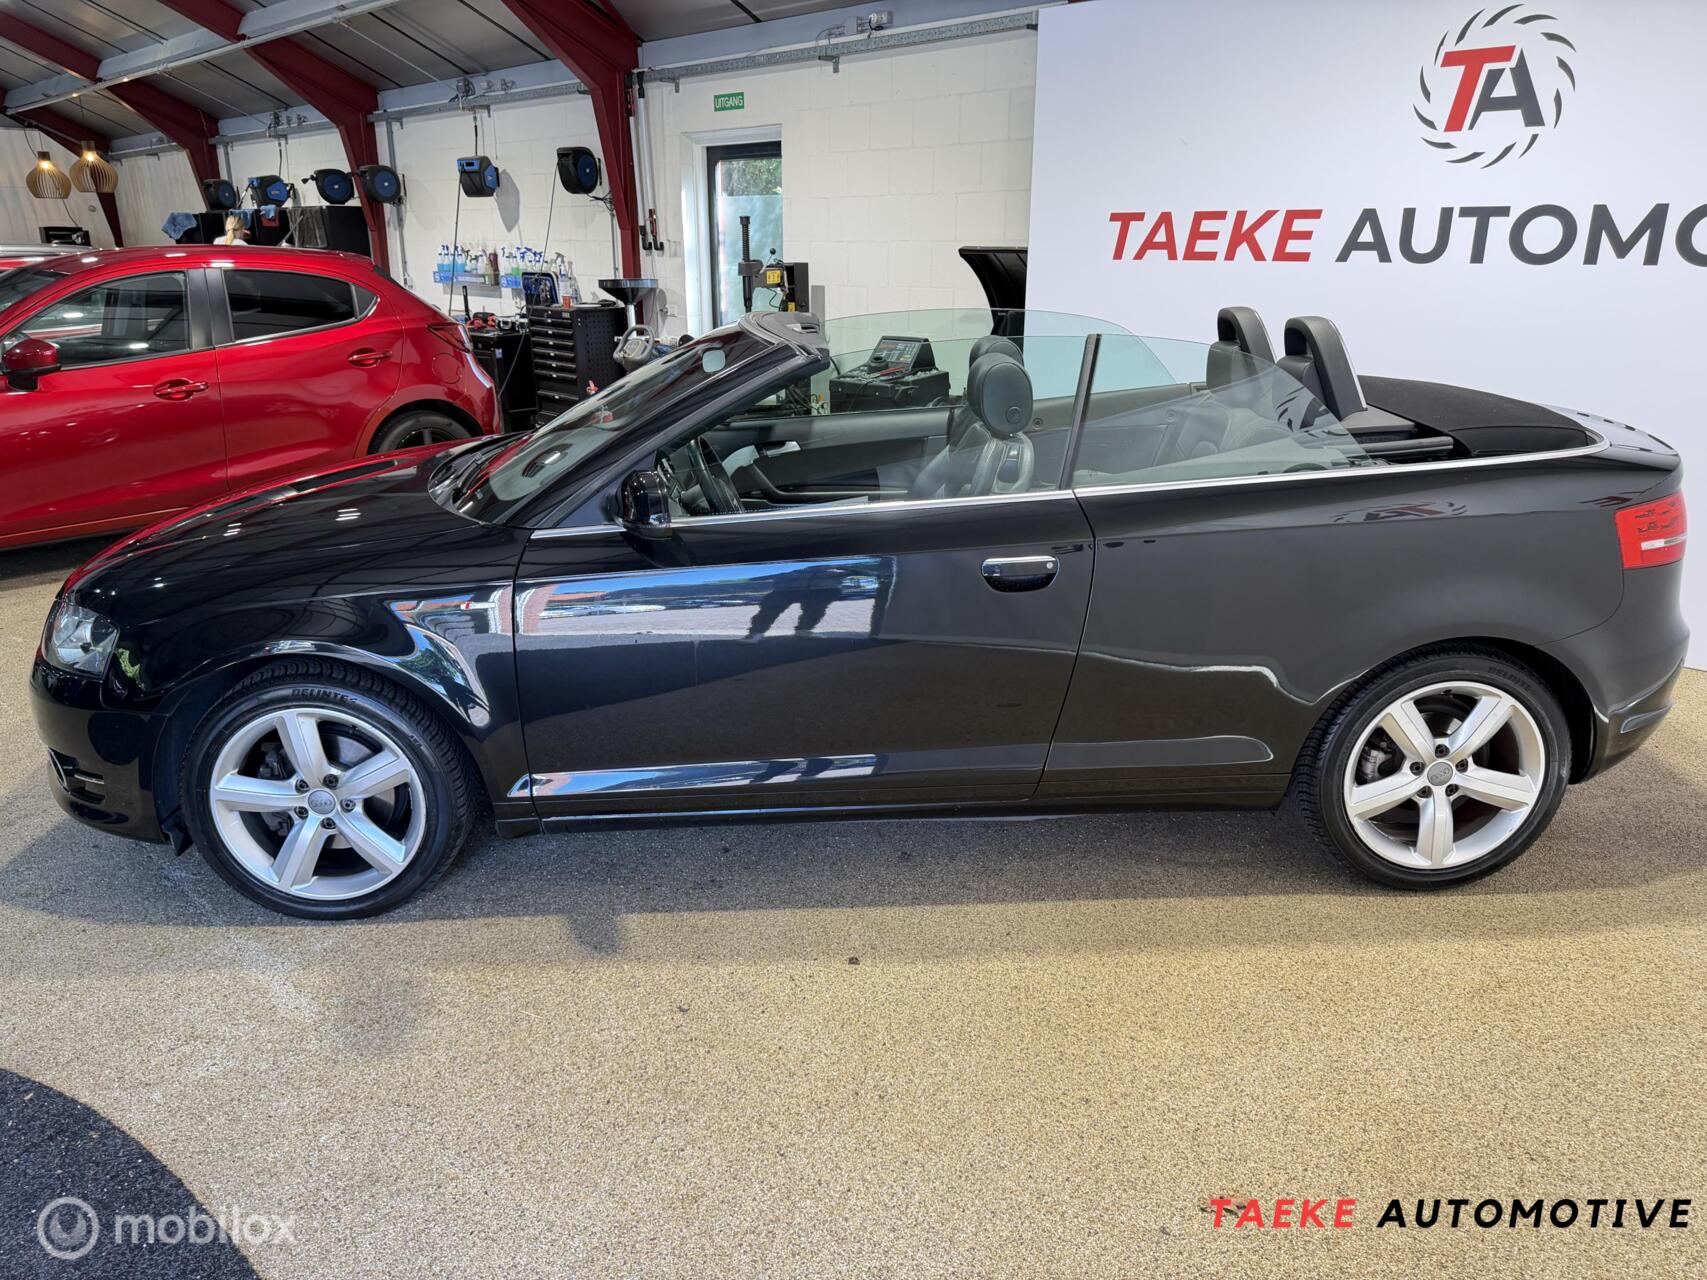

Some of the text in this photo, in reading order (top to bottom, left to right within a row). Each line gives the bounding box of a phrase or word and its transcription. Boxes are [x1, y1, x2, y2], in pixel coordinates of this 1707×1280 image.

[715, 95, 743, 108] UITGANG
[1440, 45, 1545, 132] TA
[1108, 208, 1323, 263] TAEKE
